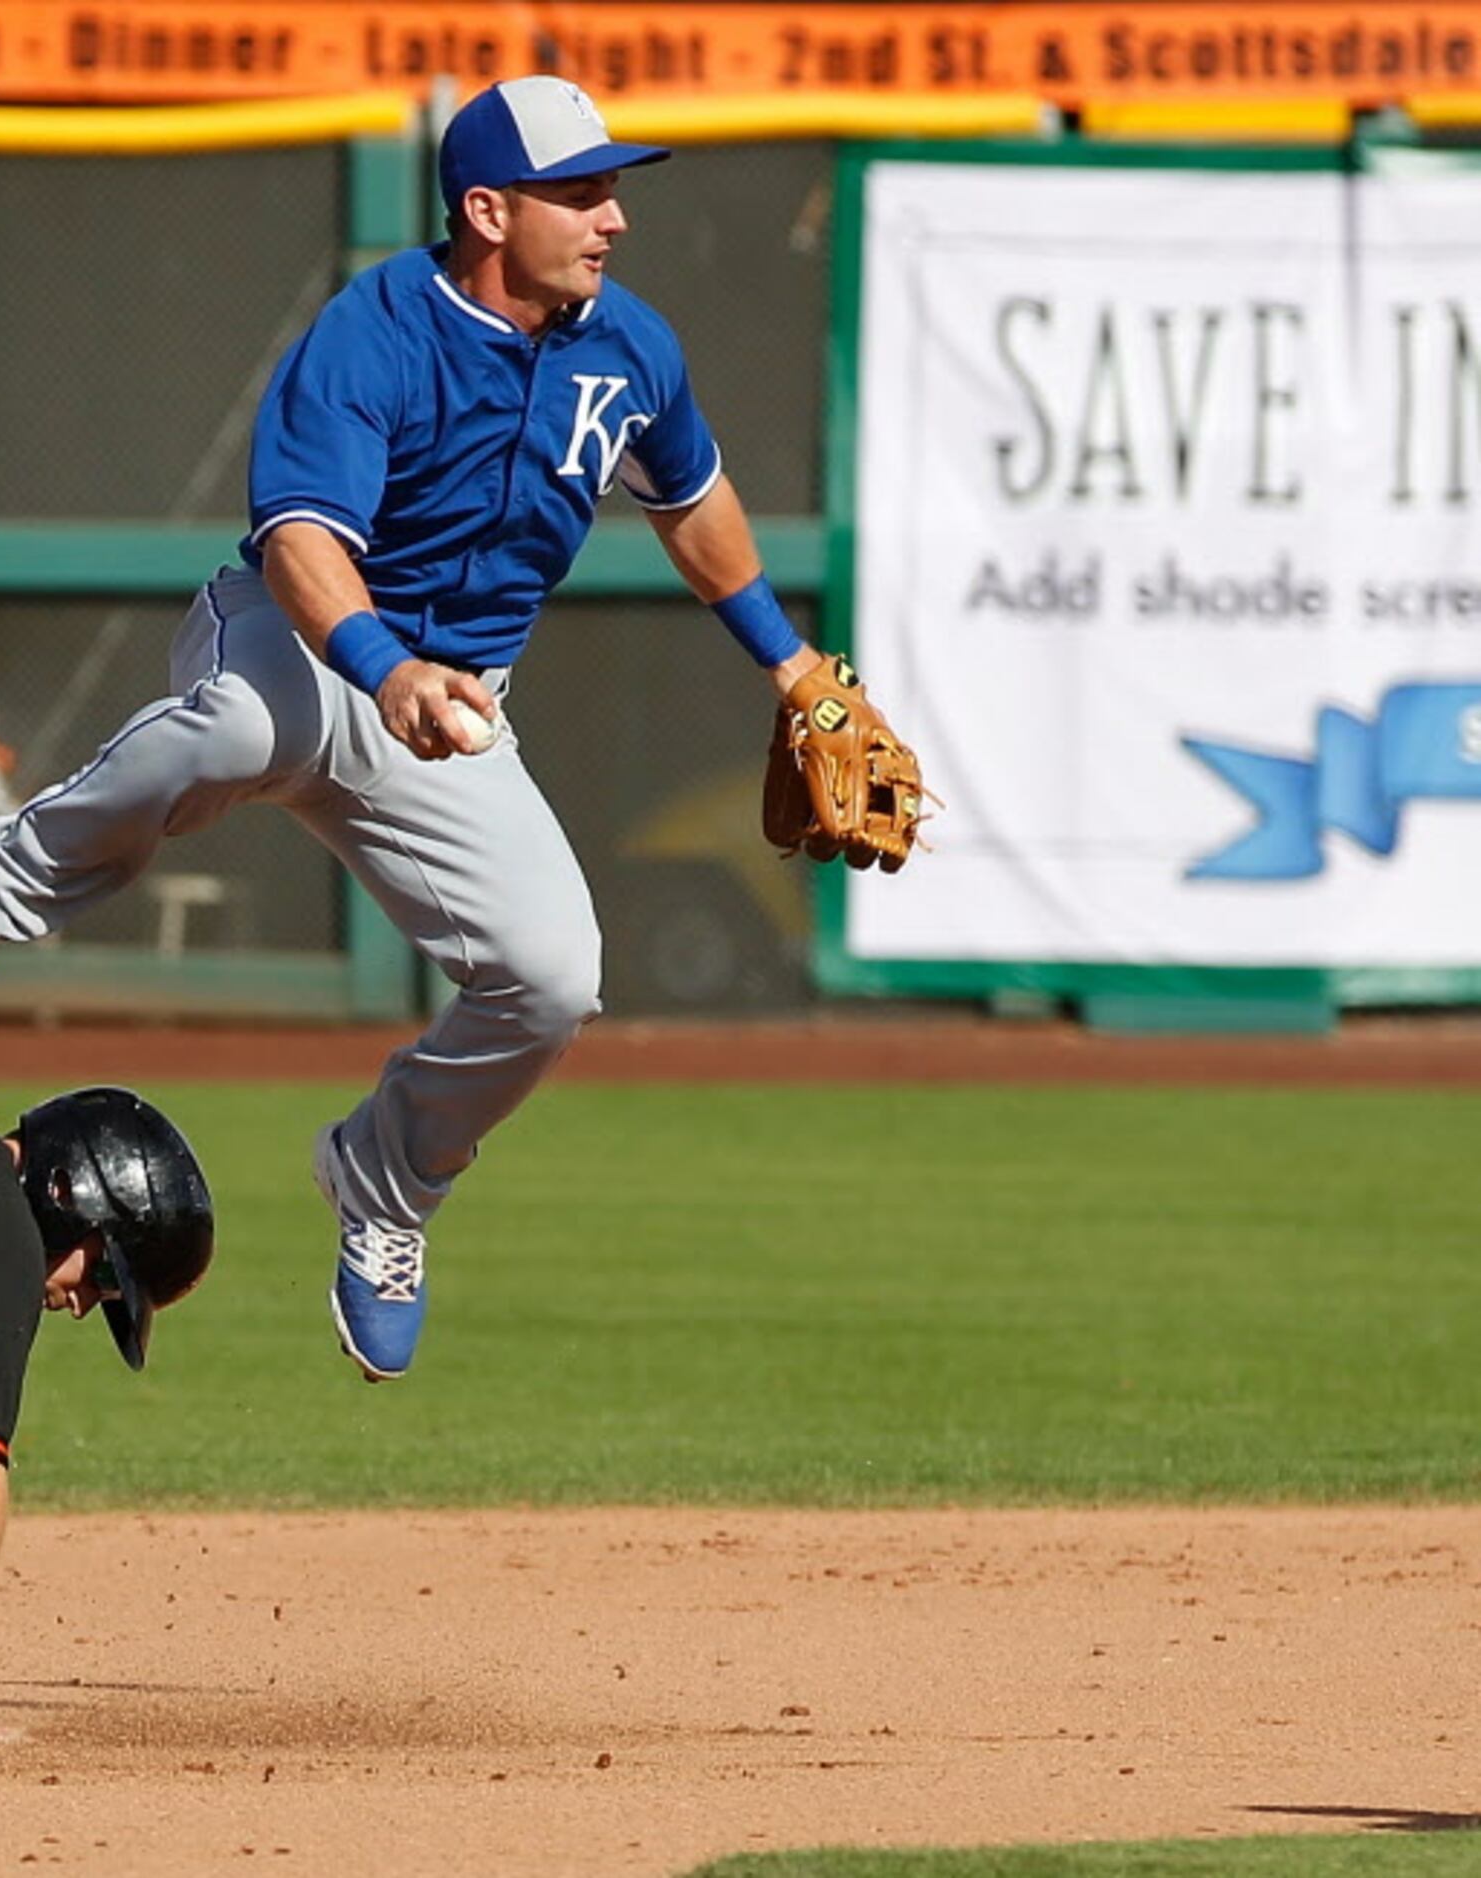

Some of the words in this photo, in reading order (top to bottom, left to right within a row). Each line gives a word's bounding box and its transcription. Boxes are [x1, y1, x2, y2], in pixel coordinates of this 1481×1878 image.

[69, 13, 293, 71] Dinner
[364, 18, 502, 77] Late
[777, 22, 900, 84] 2nd
[1102, 22, 1475, 84] Scottsdale
[992, 294, 1304, 506] SAVE
[964, 550, 1102, 613] Add
[1133, 550, 1332, 617] shade
